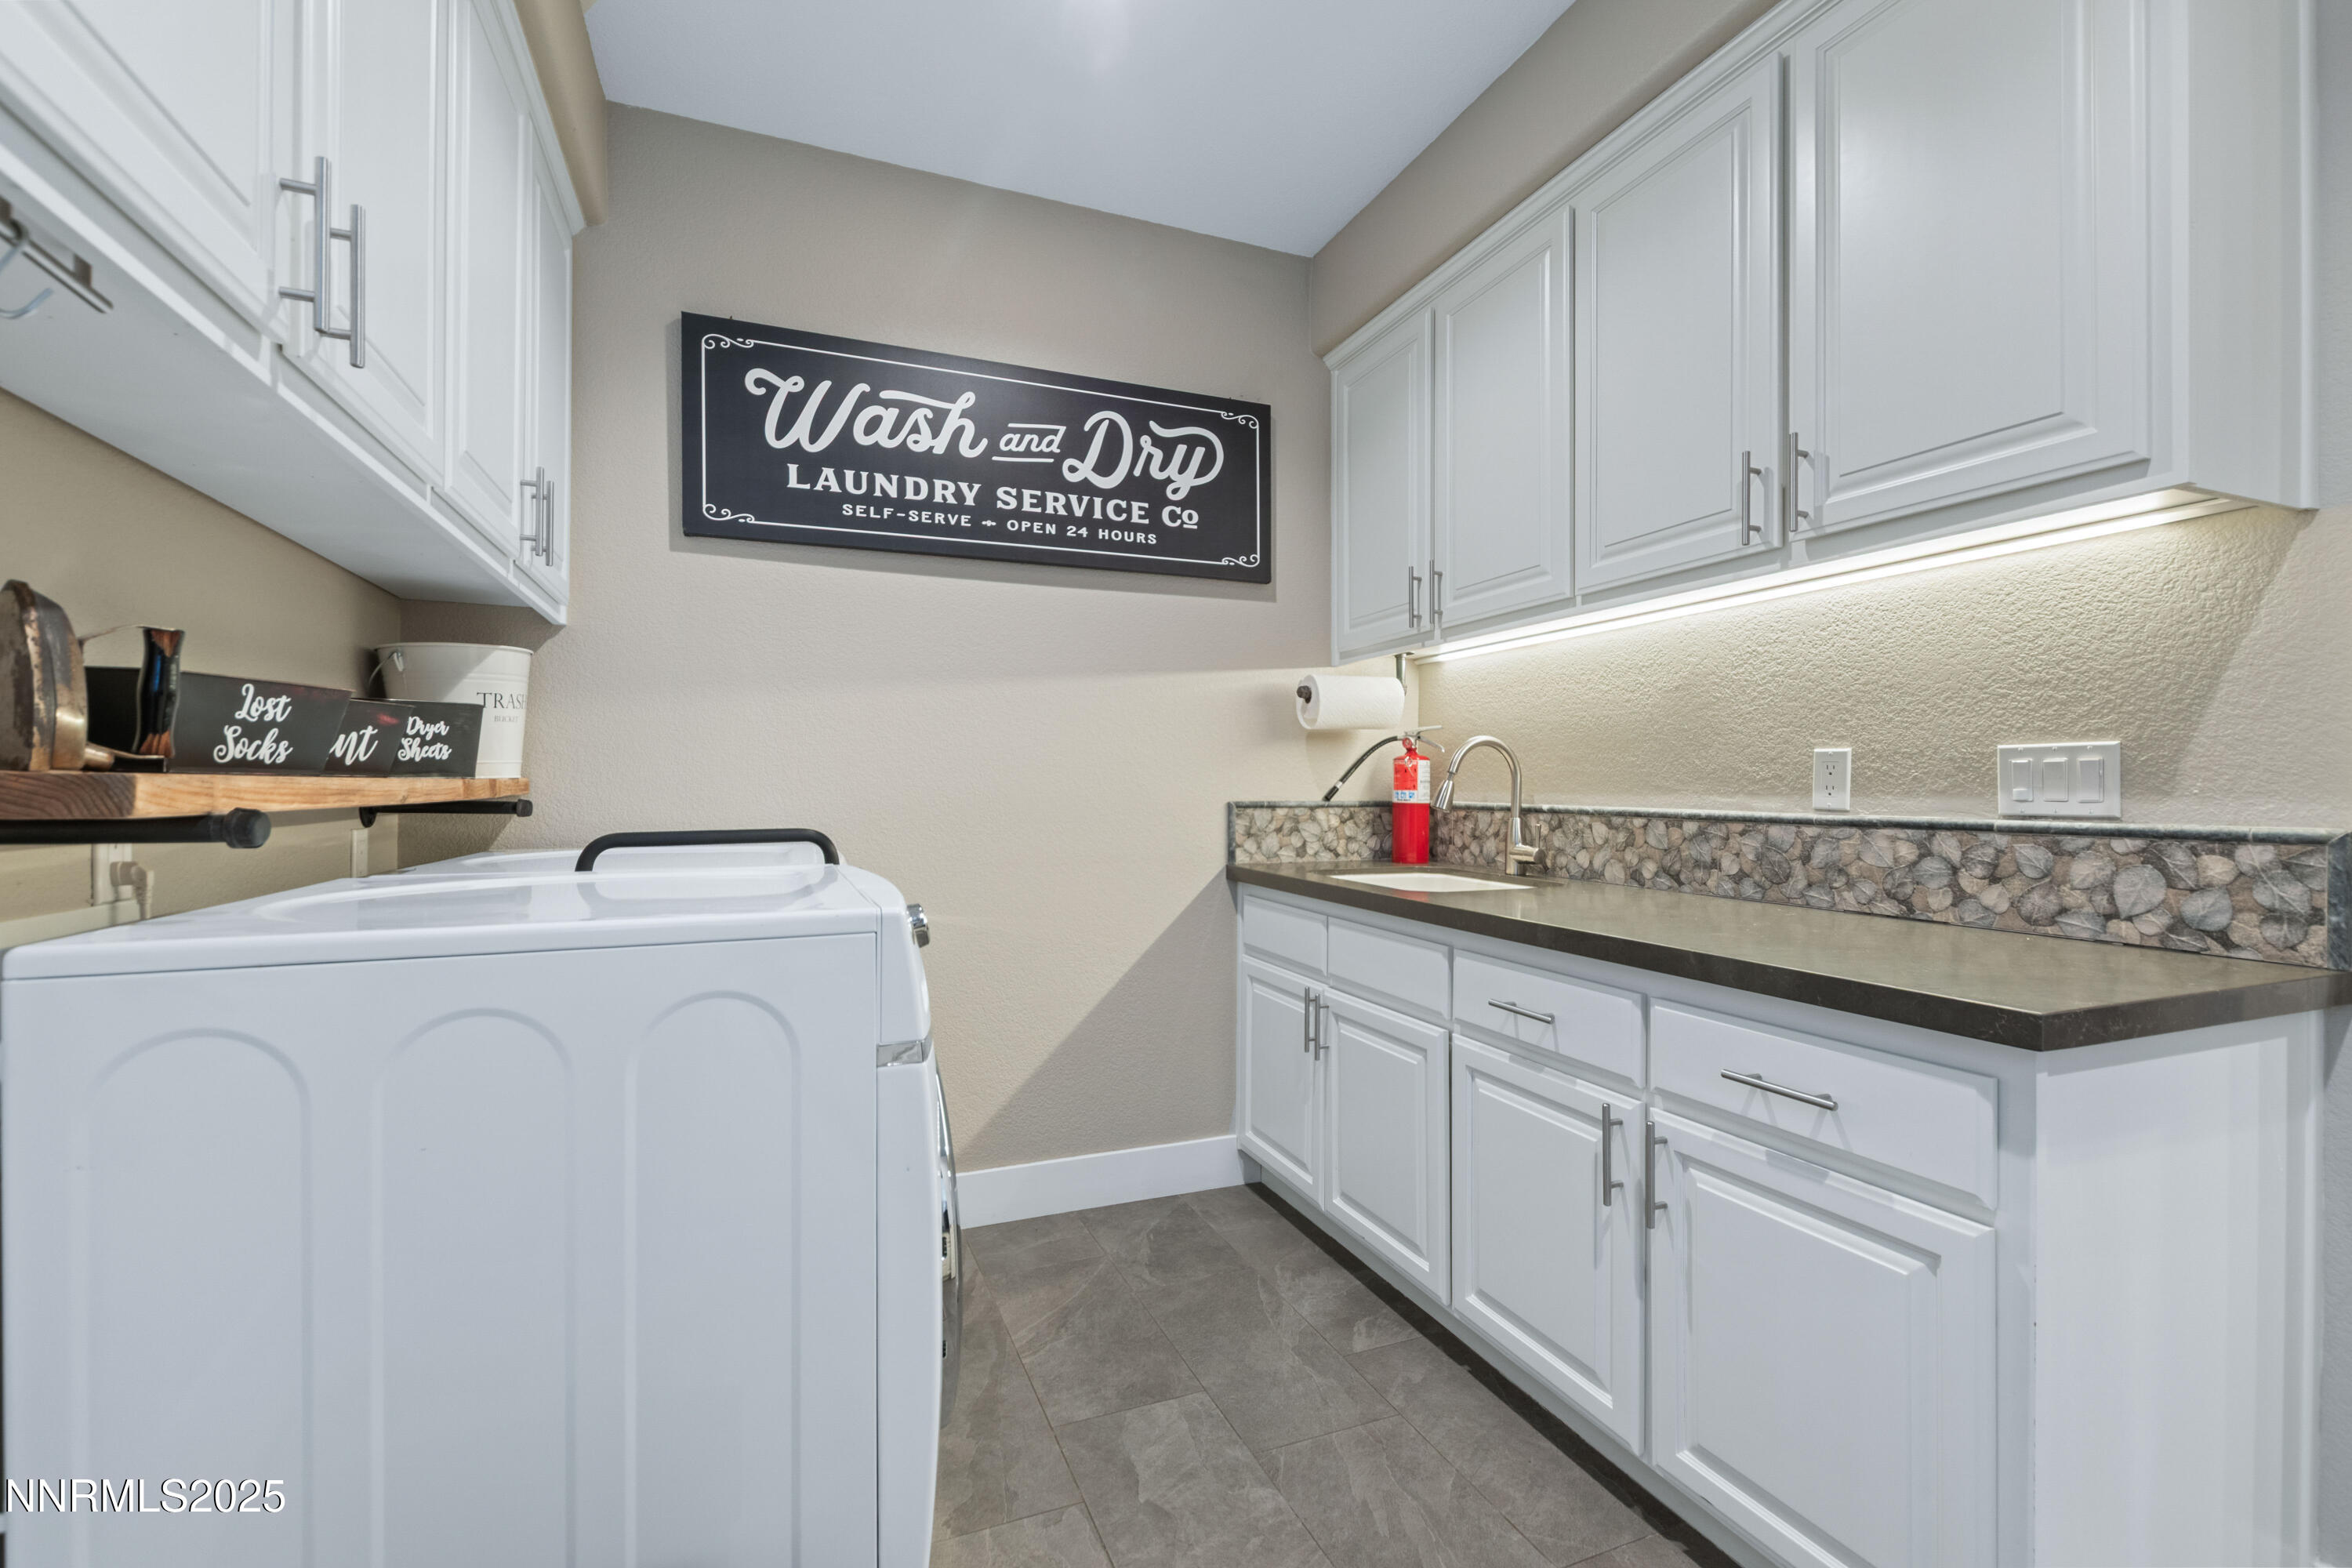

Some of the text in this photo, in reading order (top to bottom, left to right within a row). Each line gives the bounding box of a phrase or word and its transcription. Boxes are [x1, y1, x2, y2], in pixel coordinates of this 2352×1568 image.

[745, 368, 1225, 501] Wash and Dry
[786, 463, 982, 506] LAUNDRY
[996, 486, 1149, 524] SERVICE
[842, 503, 1157, 544] SELF-SERVE OPEN 24 HOURS
[234, 683, 292, 722] Lost
[213, 725, 293, 764] Socks
[328, 725, 379, 766] nt
[405, 716, 450, 741] Dryer
[397, 737, 452, 762] Sheets
